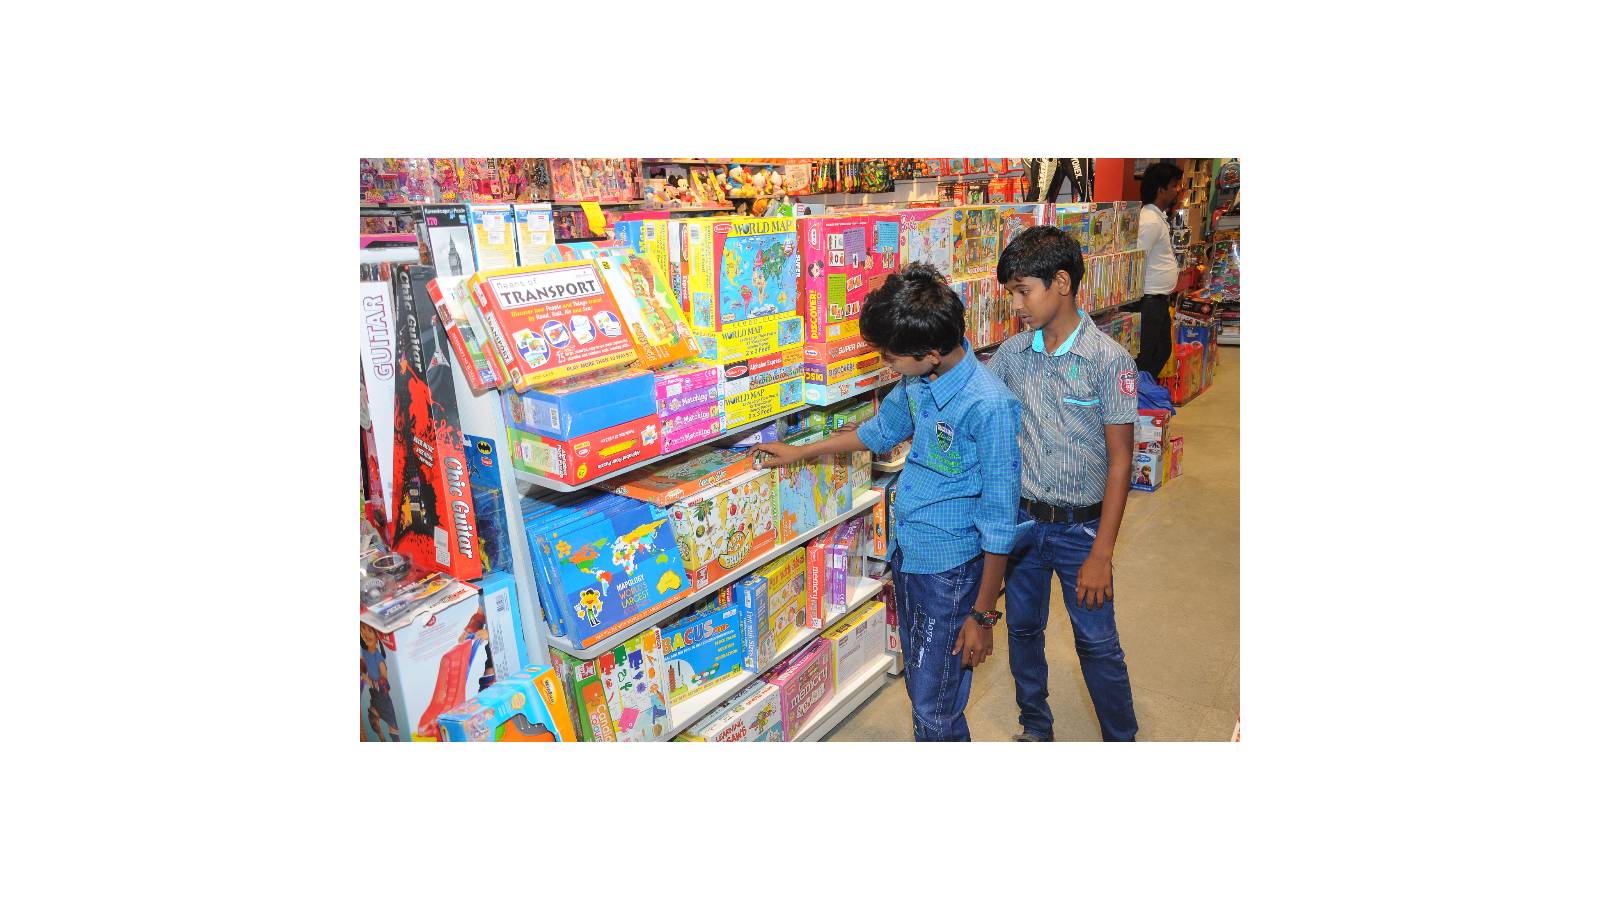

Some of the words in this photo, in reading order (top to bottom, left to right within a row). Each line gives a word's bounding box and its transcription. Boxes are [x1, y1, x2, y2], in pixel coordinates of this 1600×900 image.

[733, 222, 770, 234] WORLD
[771, 220, 792, 232] MAP
[500, 280, 596, 305] TRANSPORT
[363, 295, 394, 381] GUITAR
[838, 344, 856, 355] SUPER
[682, 394, 708, 406] Matching
[683, 412, 710, 424] Matching
[685, 428, 710, 442] Matching
[444, 456, 466, 497] Chic
[452, 501, 473, 558] Guitar
[616, 574, 645, 592] MAPOLOGY
[810, 566, 819, 600] memory
[621, 591, 650, 609] LARGEST
[661, 620, 713, 655] BACUS
[927, 618, 936, 643] Boys
[790, 668, 828, 708] memory
